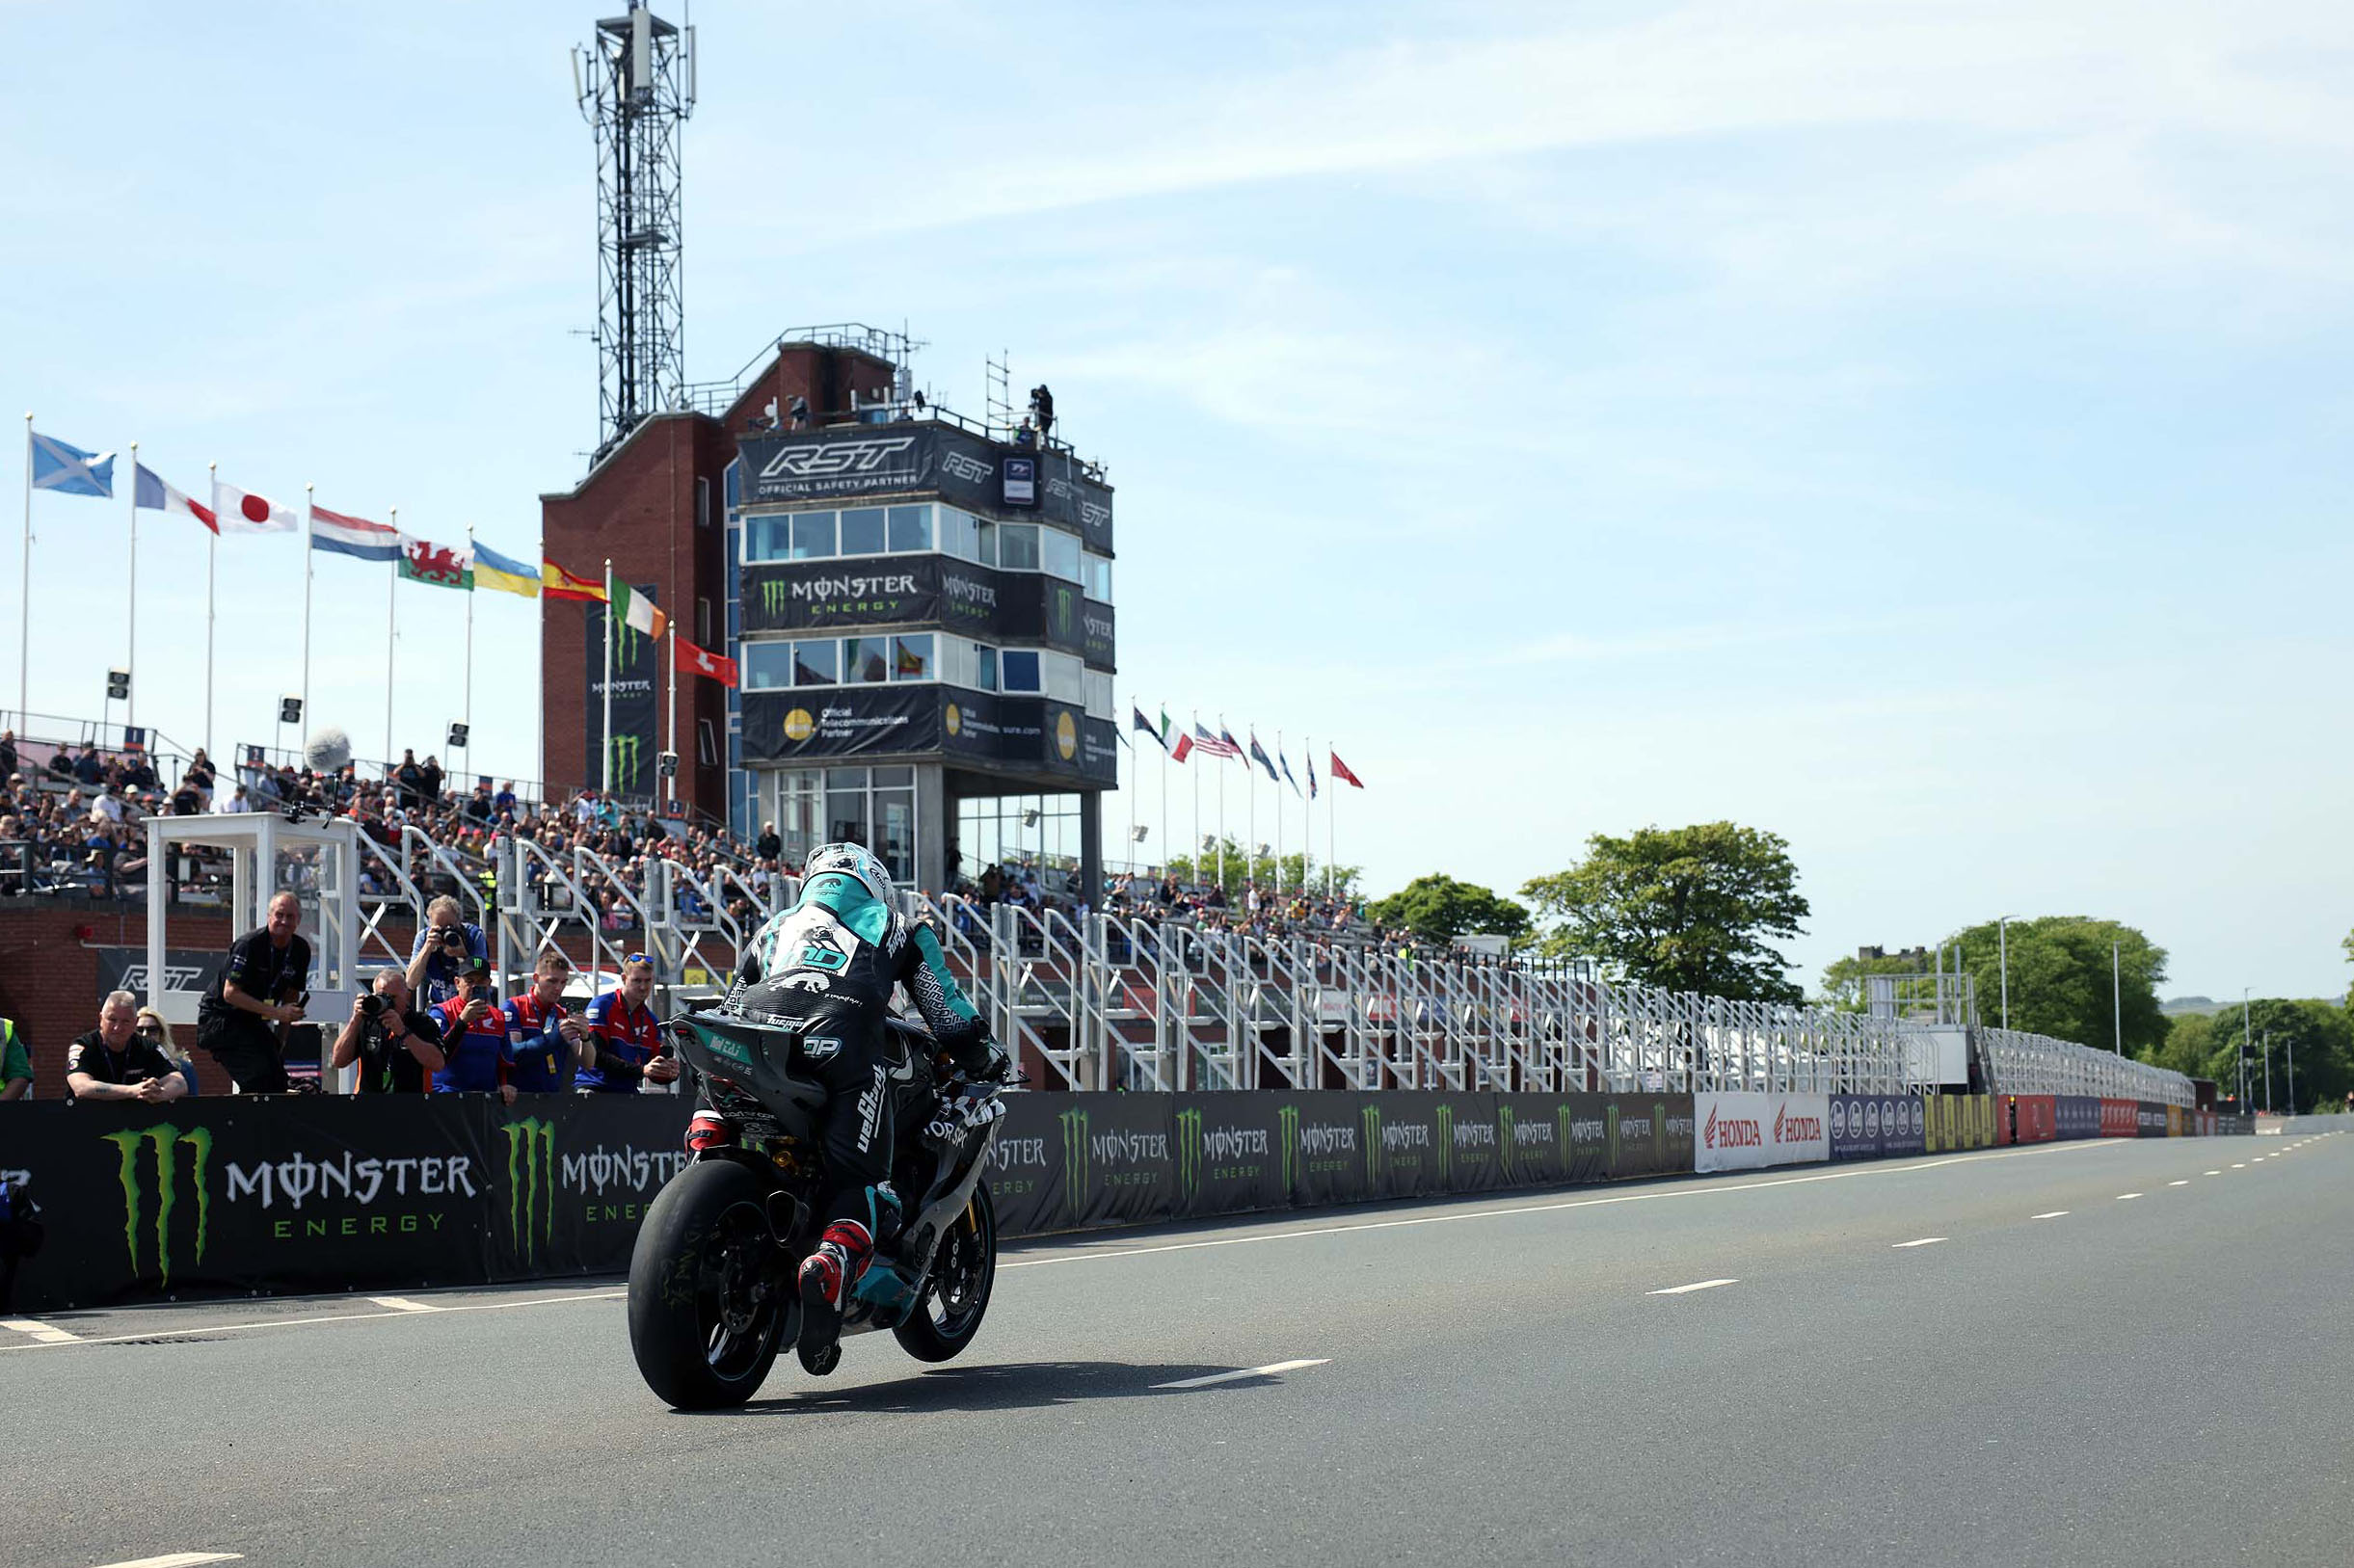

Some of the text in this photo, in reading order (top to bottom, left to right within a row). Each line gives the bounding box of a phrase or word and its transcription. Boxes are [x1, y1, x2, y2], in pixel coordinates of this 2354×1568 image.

[760, 437, 915, 477] RST
[942, 451, 994, 484] RST
[759, 475, 917, 495] OFFICIAL SAFETY PARTNER
[791, 575, 918, 601] MONSTER
[943, 573, 997, 608] MONSTER
[811, 600, 899, 615] ENERGY
[592, 679, 651, 694] MNSTER
[118, 965, 203, 992] RT
[1203, 1125, 1269, 1162] MONSTER
[1300, 1122, 1355, 1156] MONSTER
[1381, 1120, 1430, 1153] MONSTER
[1454, 1119, 1495, 1149] MONSTER
[1513, 1118, 1553, 1147] MONSTER
[1718, 1120, 1762, 1148] HONDA
[1785, 1118, 1822, 1142] HONDA
[986, 1136, 1047, 1171] NSTER
[1092, 1129, 1169, 1166] MONSTER
[225, 1151, 477, 1210] MONSTER
[562, 1144, 688, 1196] MONSTE
[1104, 1171, 1158, 1186] ENERGY
[1214, 1165, 1261, 1180] ENERGY
[993, 1180, 1033, 1195] ERGY
[274, 1213, 444, 1237] ENERGY
